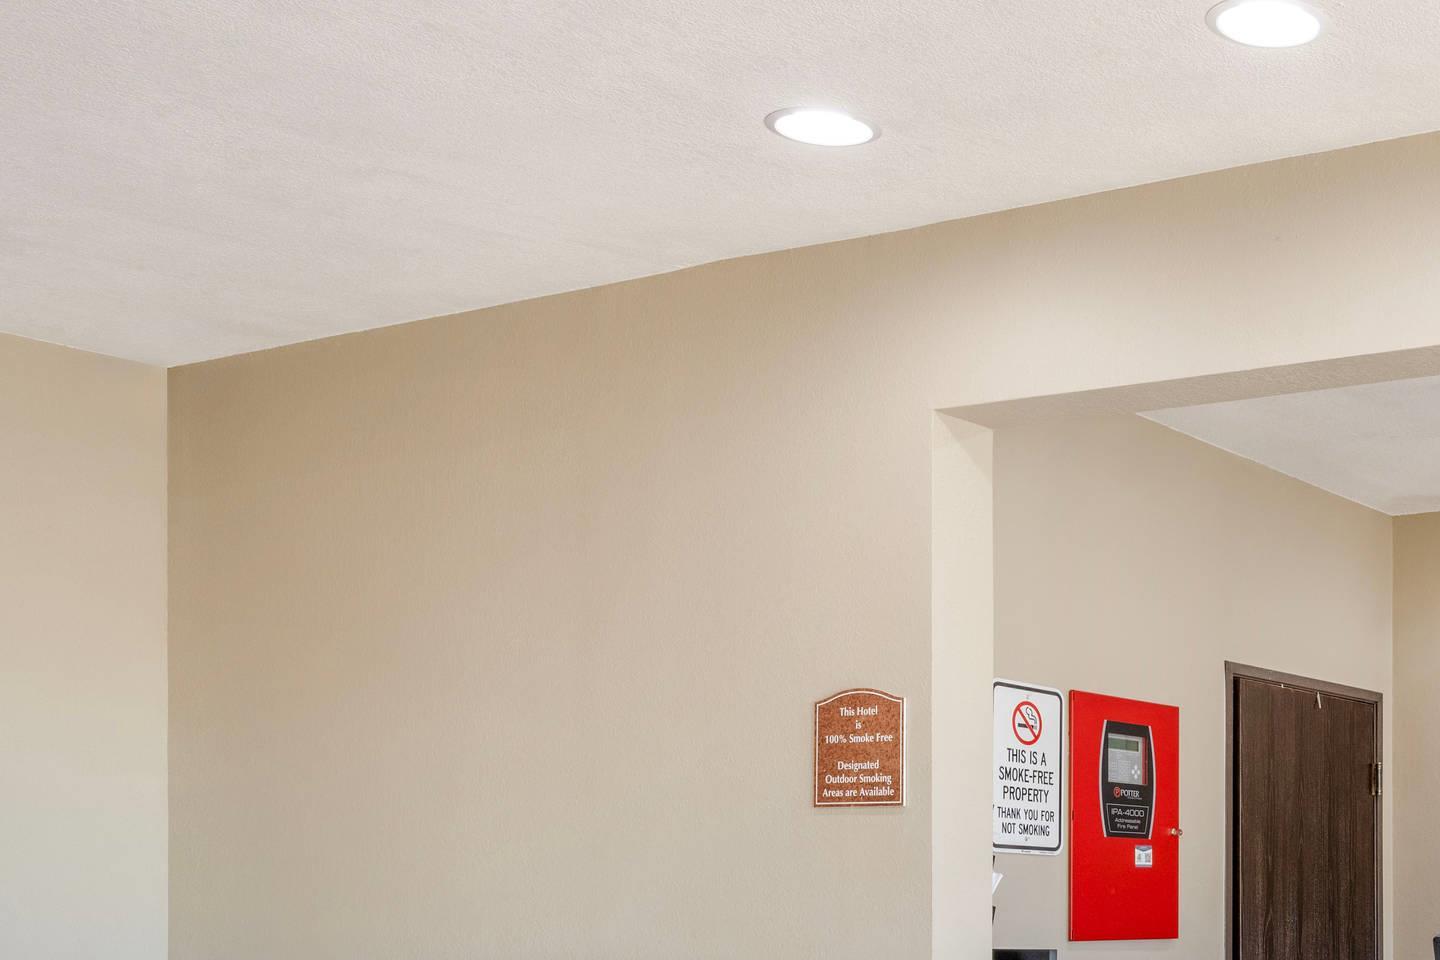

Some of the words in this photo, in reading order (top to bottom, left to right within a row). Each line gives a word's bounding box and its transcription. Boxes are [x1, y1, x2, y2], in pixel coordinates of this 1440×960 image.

[840, 707, 855, 716] This
[857, 705, 878, 716] Hotel
[855, 720, 862, 729] is
[825, 735, 847, 744] 100%
[849, 734, 874, 743] Smoke
[876, 732, 893, 742] Free
[1007, 748, 1026, 764] THIS
[1030, 751, 1038, 765] IS
[1041, 752, 1047, 766] A
[837, 760, 880, 772] Designated
[825, 774, 858, 784] Outdoor
[859, 773, 892, 785] Smoking
[999, 766, 1054, 786] SMOKE-FREE
[822, 788, 843, 797] Areas
[859, 786, 895, 797] Available
[1002, 785, 1050, 803] PROPERTY
[1120, 789, 1140, 798] POTTER
[997, 806, 1021, 820] THANK
[1024, 808, 1038, 821] YOU
[1041, 810, 1055, 822] FOR
[1111, 808, 1145, 817] IPA-4000
[1001, 822, 1016, 834] NOT
[1018, 823, 1050, 837] SMOKING
